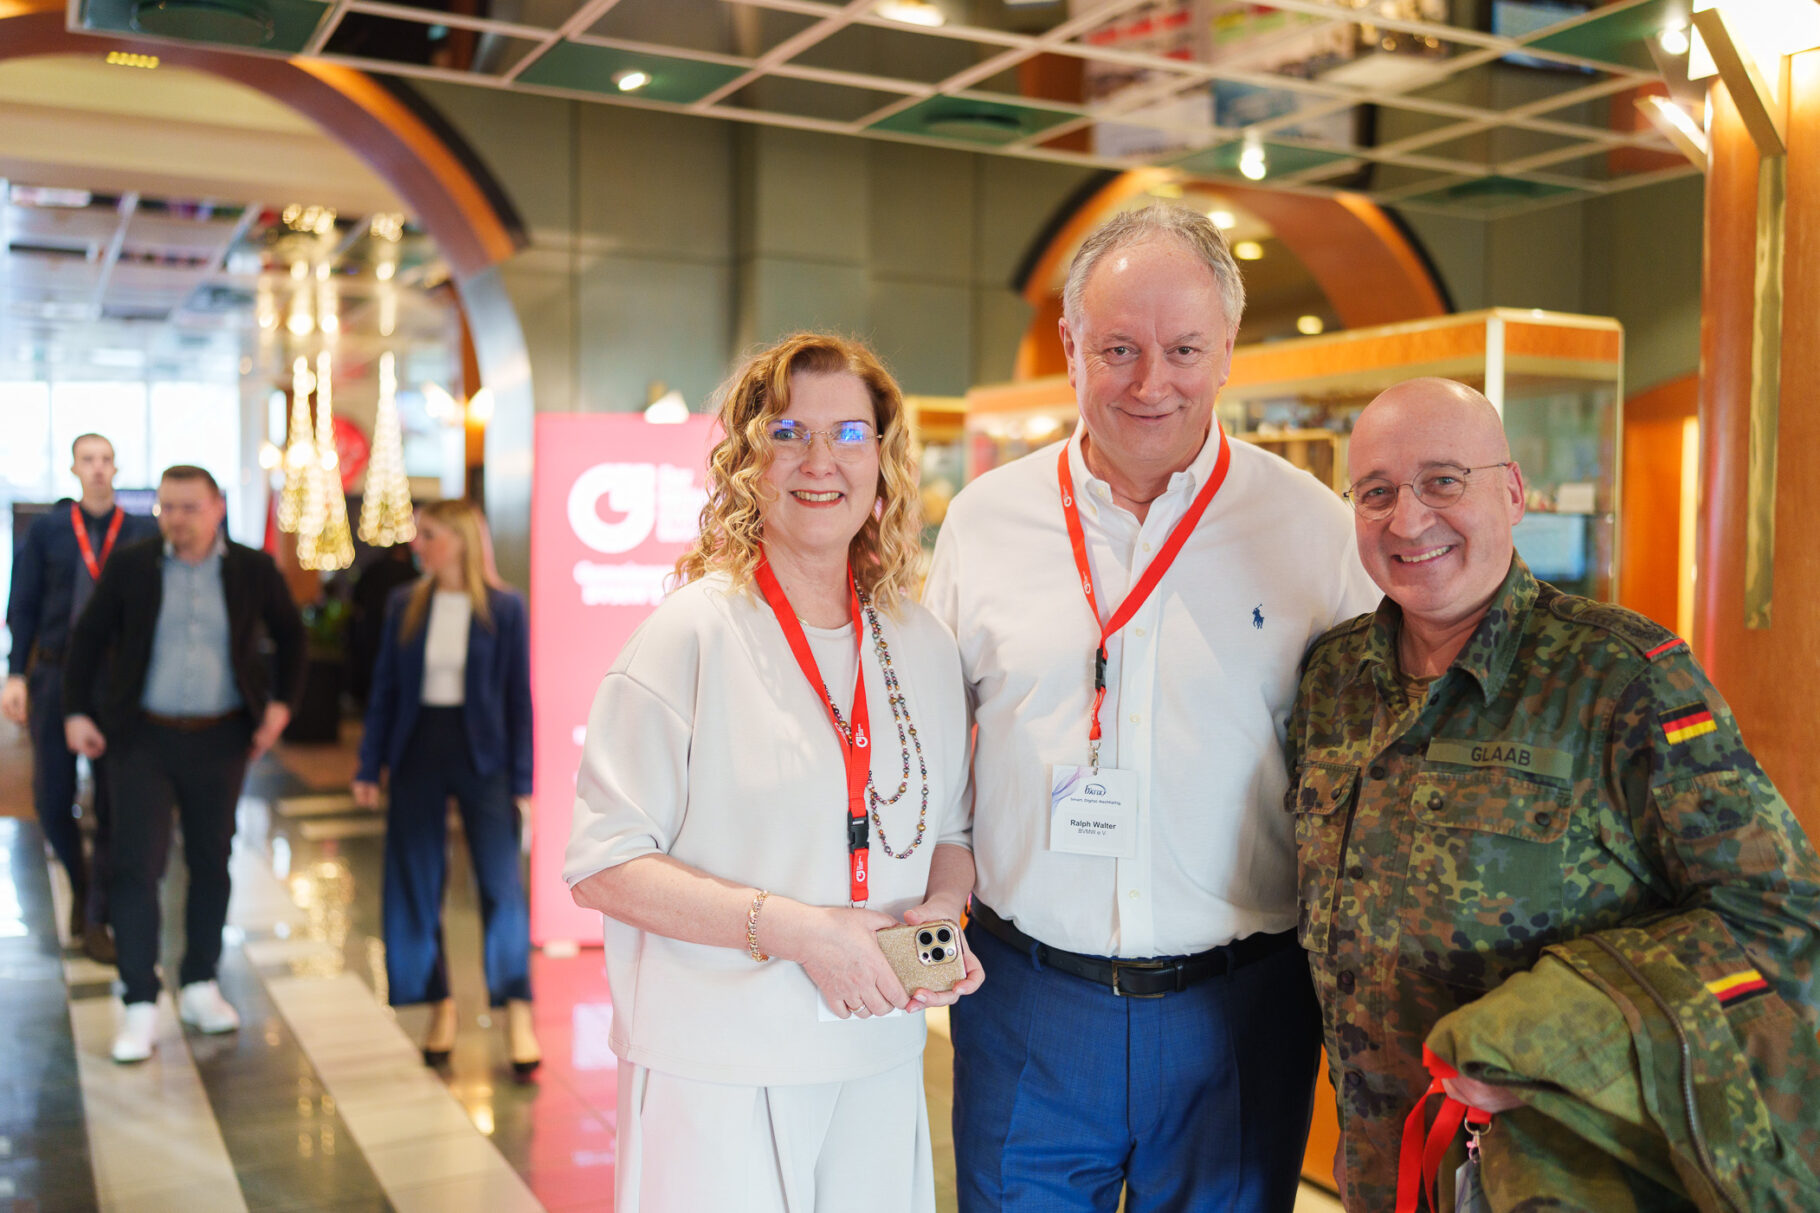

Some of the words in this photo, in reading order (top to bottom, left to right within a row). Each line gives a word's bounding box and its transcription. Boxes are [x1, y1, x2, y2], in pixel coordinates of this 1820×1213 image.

[1471, 746, 1531, 766] GLAAB
[1070, 819, 1091, 828] Ralph
[1092, 821, 1116, 829] Walter
